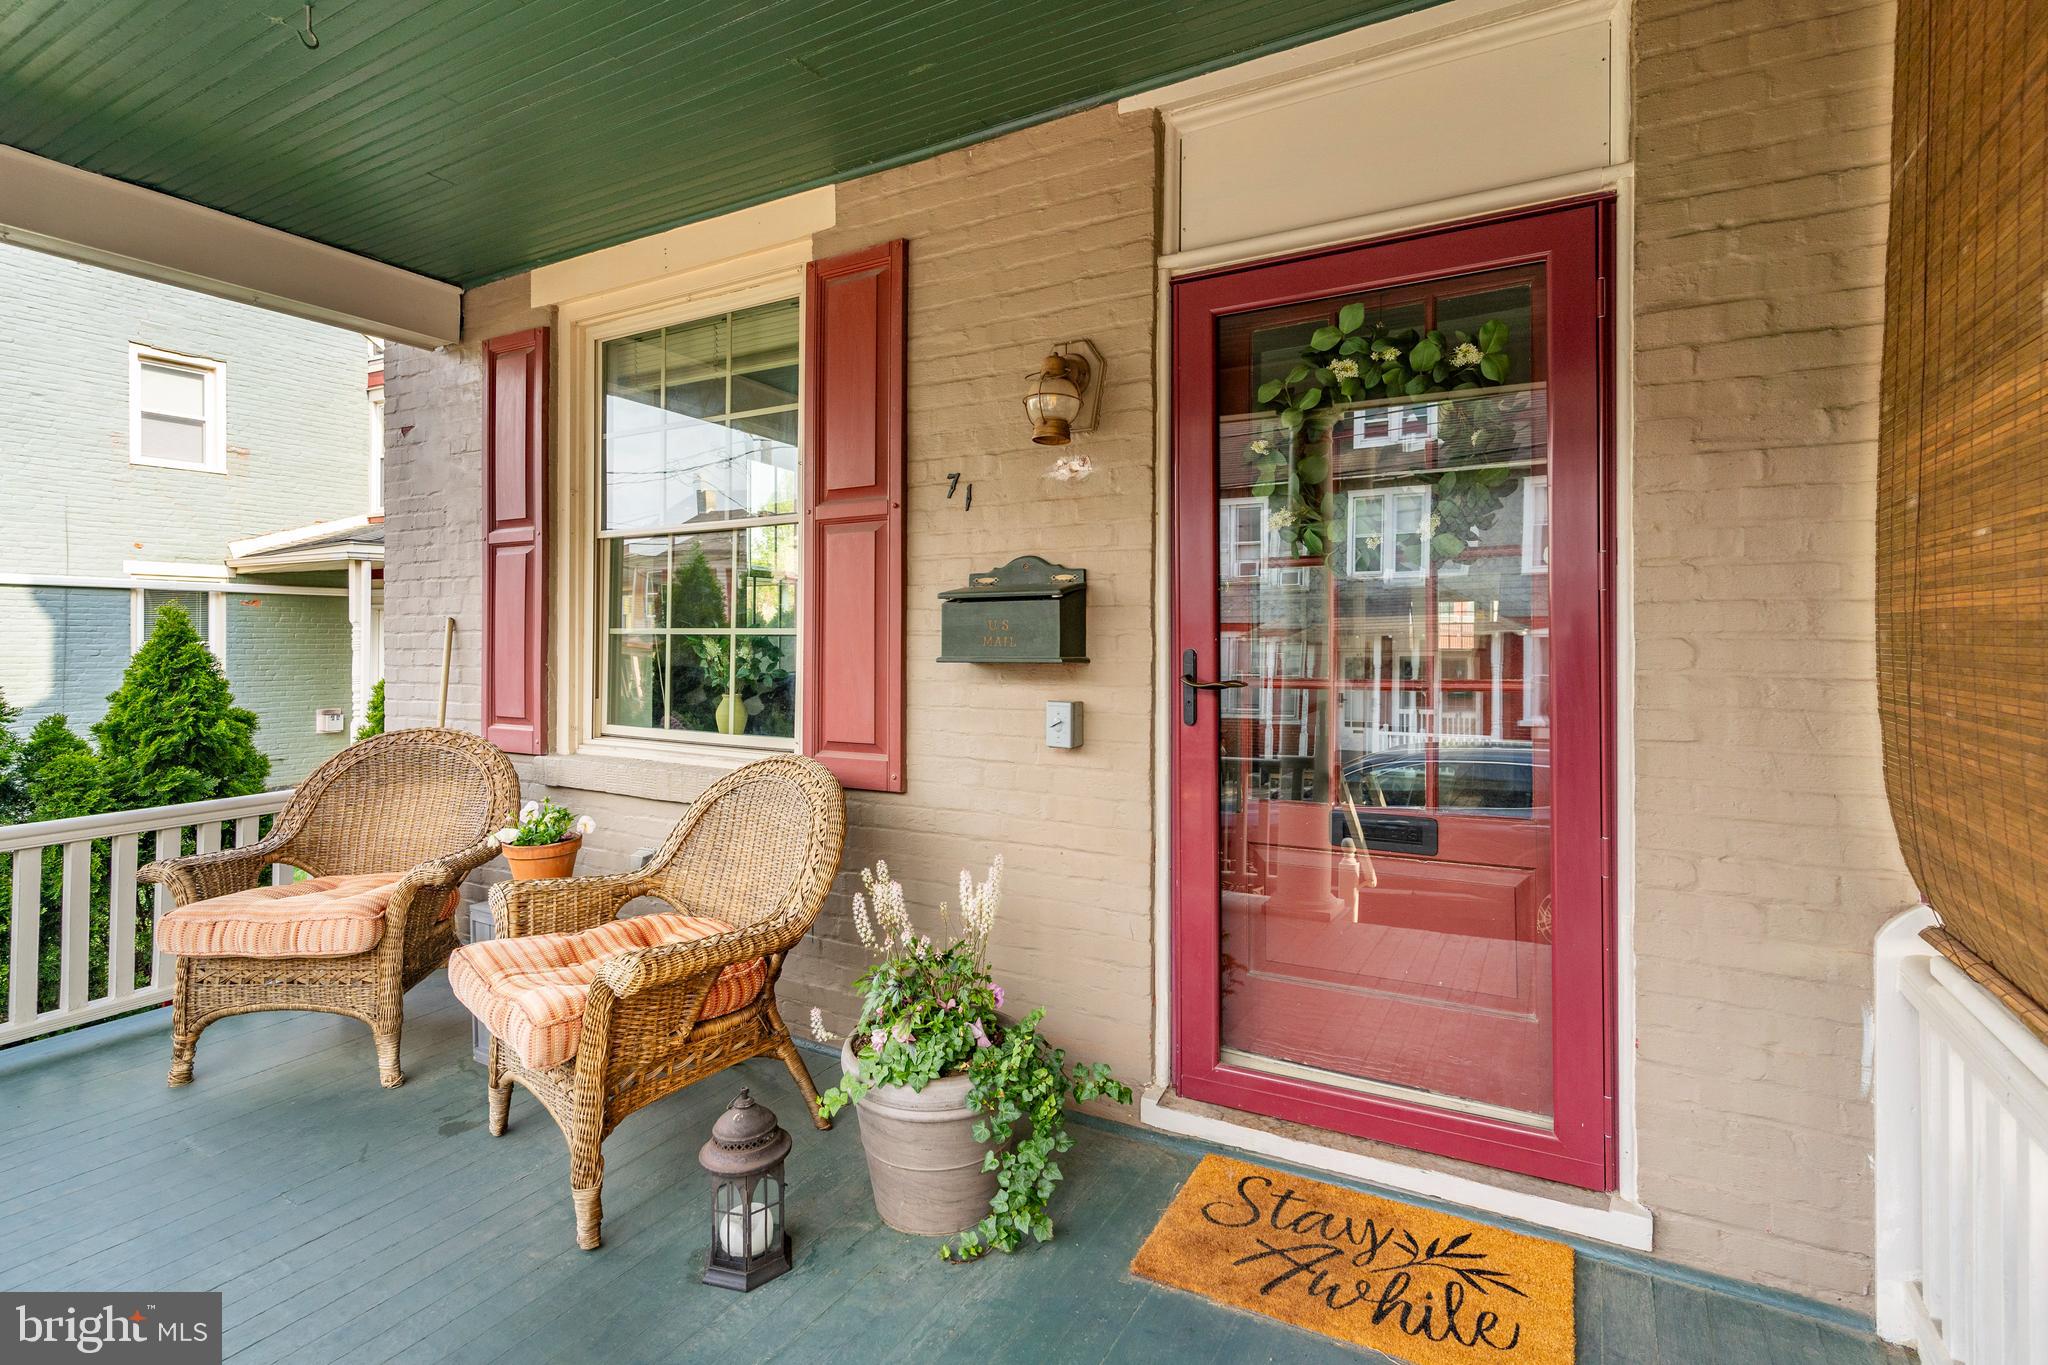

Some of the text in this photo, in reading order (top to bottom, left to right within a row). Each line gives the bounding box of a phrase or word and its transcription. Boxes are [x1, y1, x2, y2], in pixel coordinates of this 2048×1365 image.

[946, 472, 973, 512] 71
[983, 635, 1017, 648] MAIL
[1201, 1175, 1395, 1267] Stay
